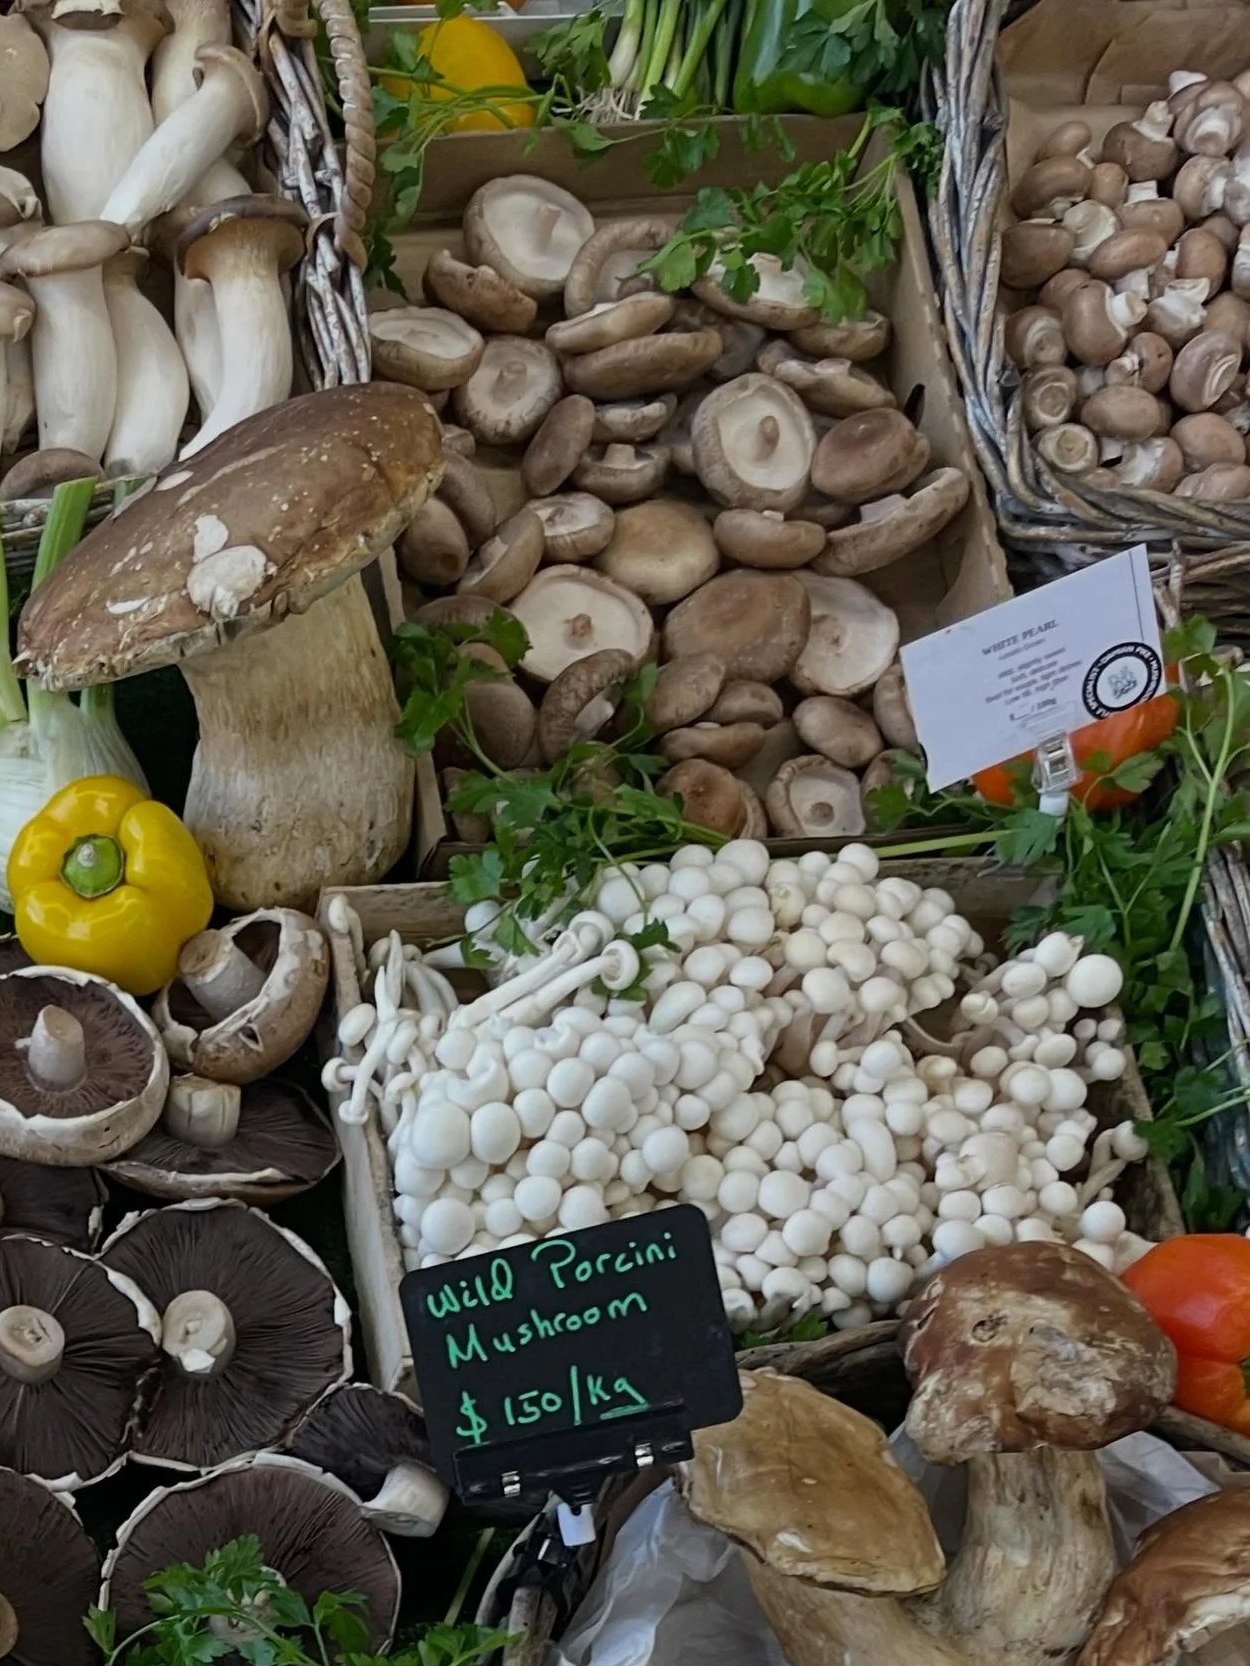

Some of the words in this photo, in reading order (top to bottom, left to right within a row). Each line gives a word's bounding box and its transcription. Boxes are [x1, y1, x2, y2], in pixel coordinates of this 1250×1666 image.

[427, 1258, 513, 1318] Wild
[531, 1232, 677, 1288] Porcini
[446, 1292, 647, 1369] Mushroom
